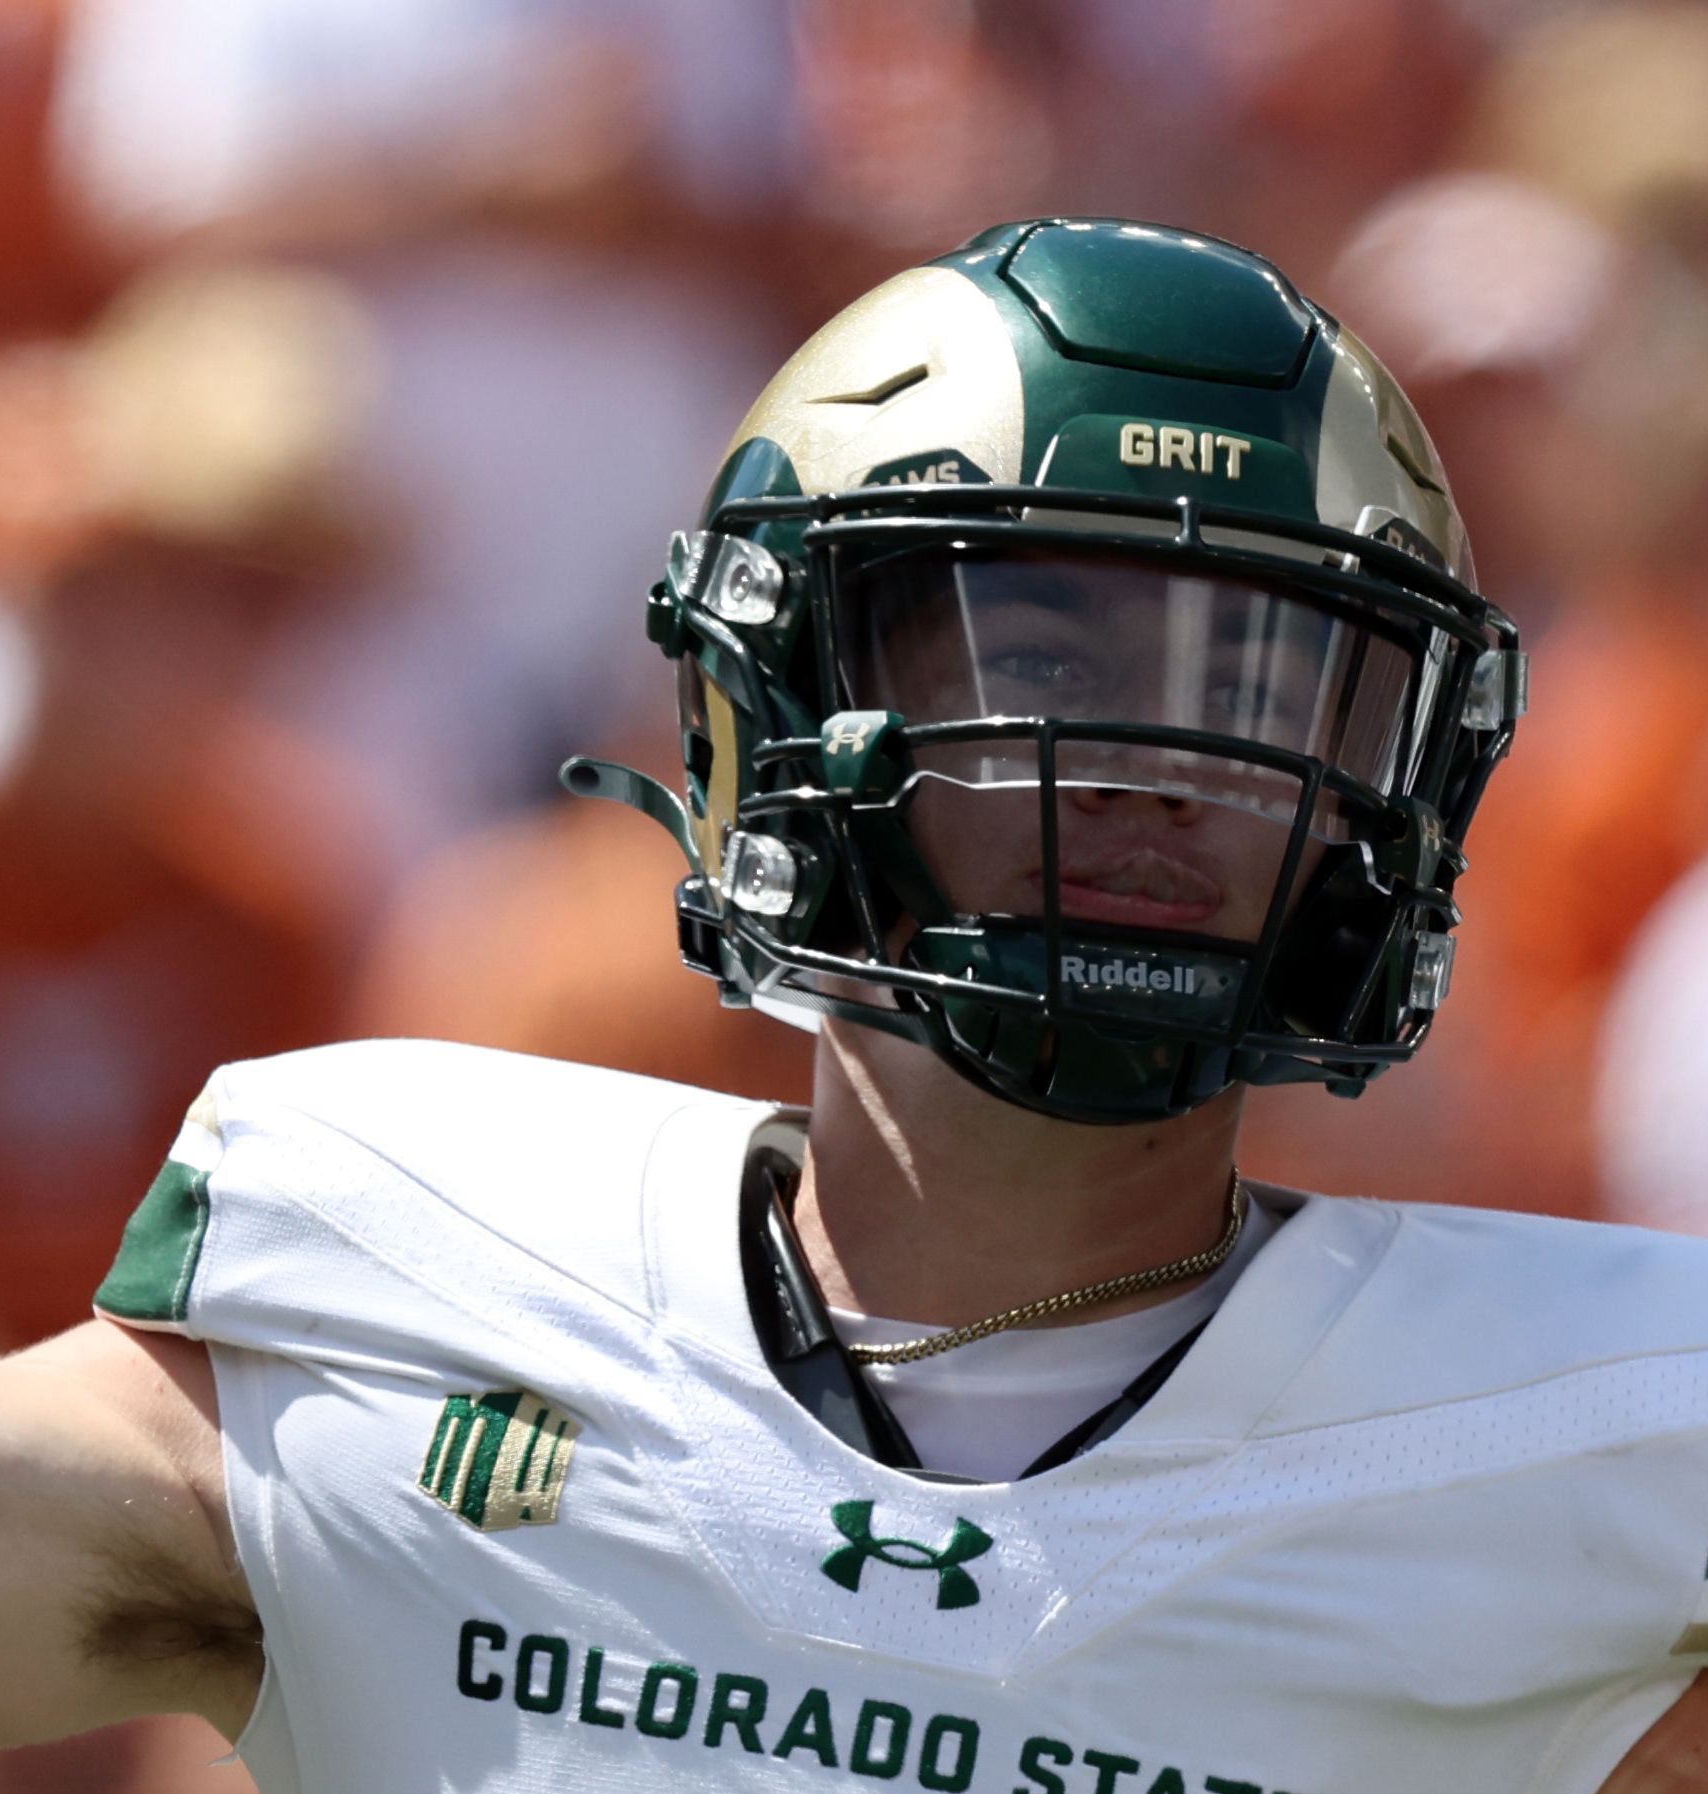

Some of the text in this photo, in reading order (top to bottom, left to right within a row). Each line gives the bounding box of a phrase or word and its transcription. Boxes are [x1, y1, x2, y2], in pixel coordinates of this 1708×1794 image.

[1119, 423, 1251, 480] GRIT
[1060, 955, 1195, 995] Riddell
[456, 1618, 980, 1794] COLORADO
